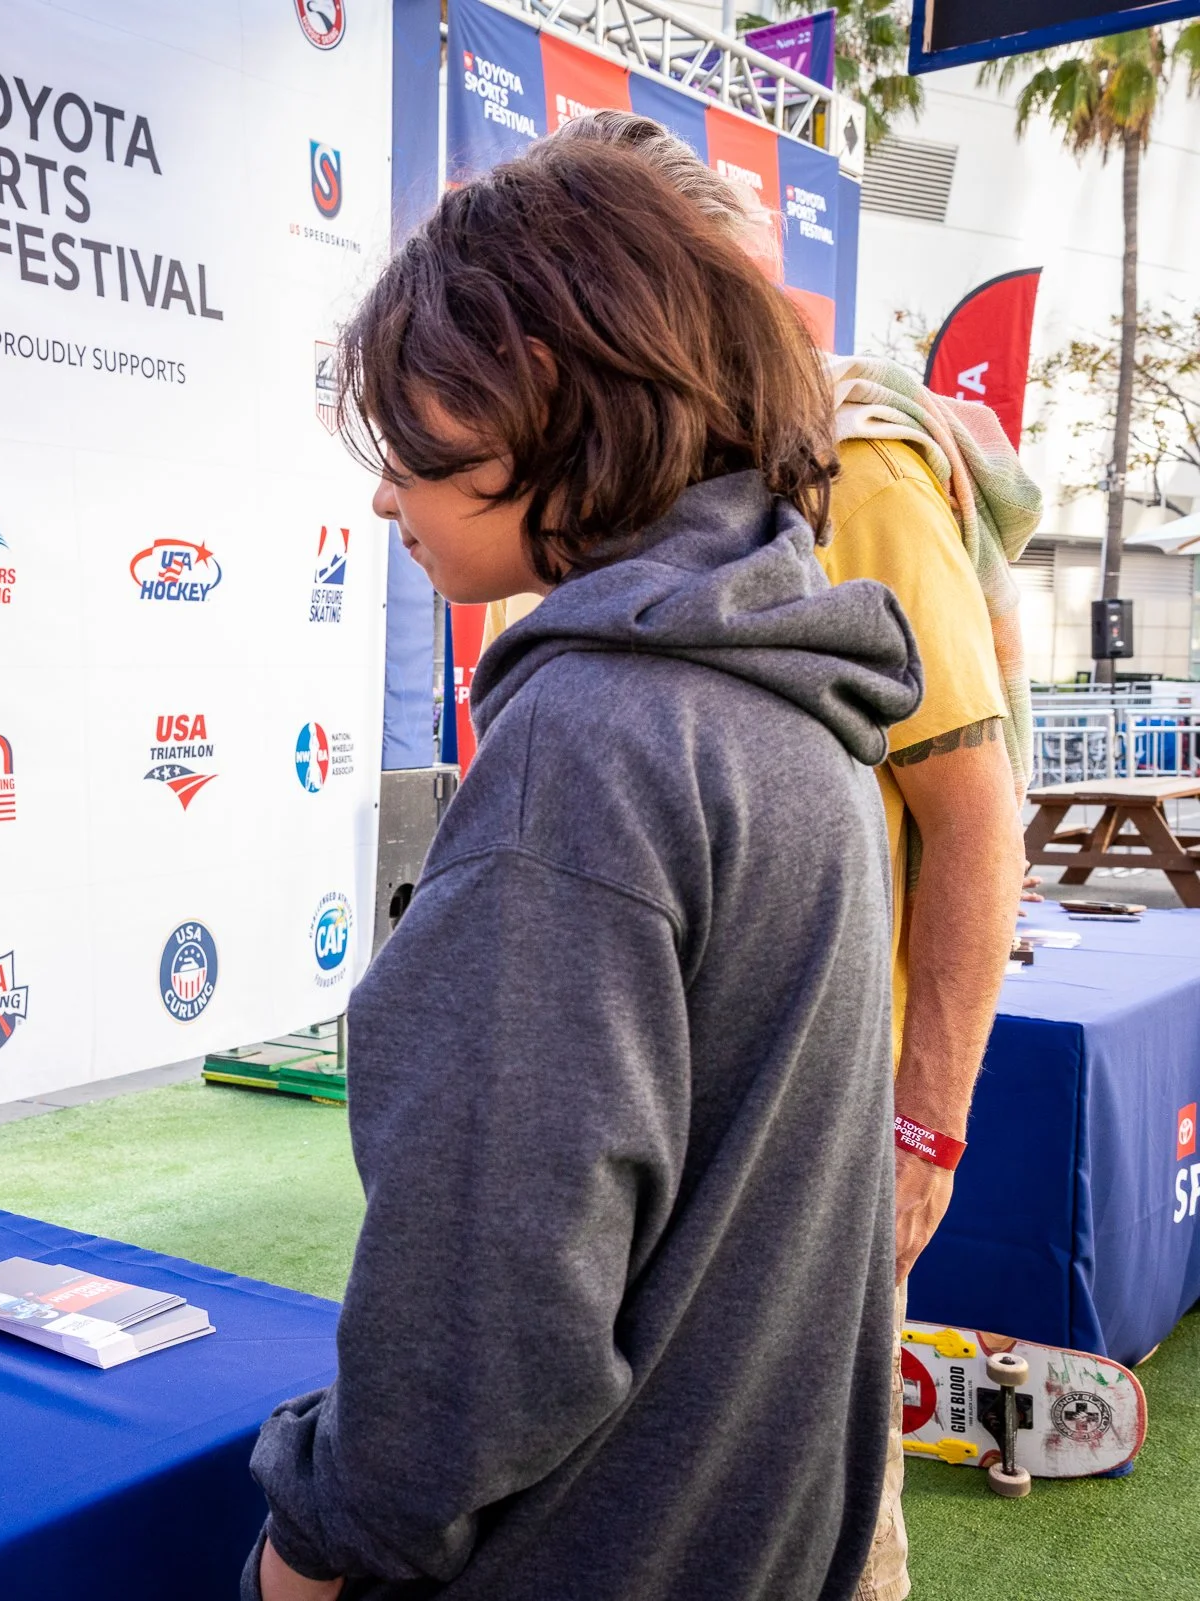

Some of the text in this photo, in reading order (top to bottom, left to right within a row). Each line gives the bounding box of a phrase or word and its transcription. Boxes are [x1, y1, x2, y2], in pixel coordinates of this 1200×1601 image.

[475, 56, 524, 95] TOYOTA
[464, 71, 509, 107] SPORTS
[484, 99, 538, 138] FESTIVAL
[289, 223, 300, 235] US
[92, 348, 186, 384] SUPPORTS
[160, 550, 192, 574] USA
[140, 580, 211, 602] HOCKEY
[309, 604, 342, 623] SKATING
[156, 714, 207, 743] USA
[150, 744, 214, 761] TRIATHLON
[175, 925, 202, 945] USA
[317, 918, 347, 959] CAF
[164, 981, 214, 1019] CURLING
[903, 1120, 936, 1142] TOYOTA
[900, 1135, 937, 1157] FESTIVAL
[949, 1365, 966, 1433] GIVE BLOOD
